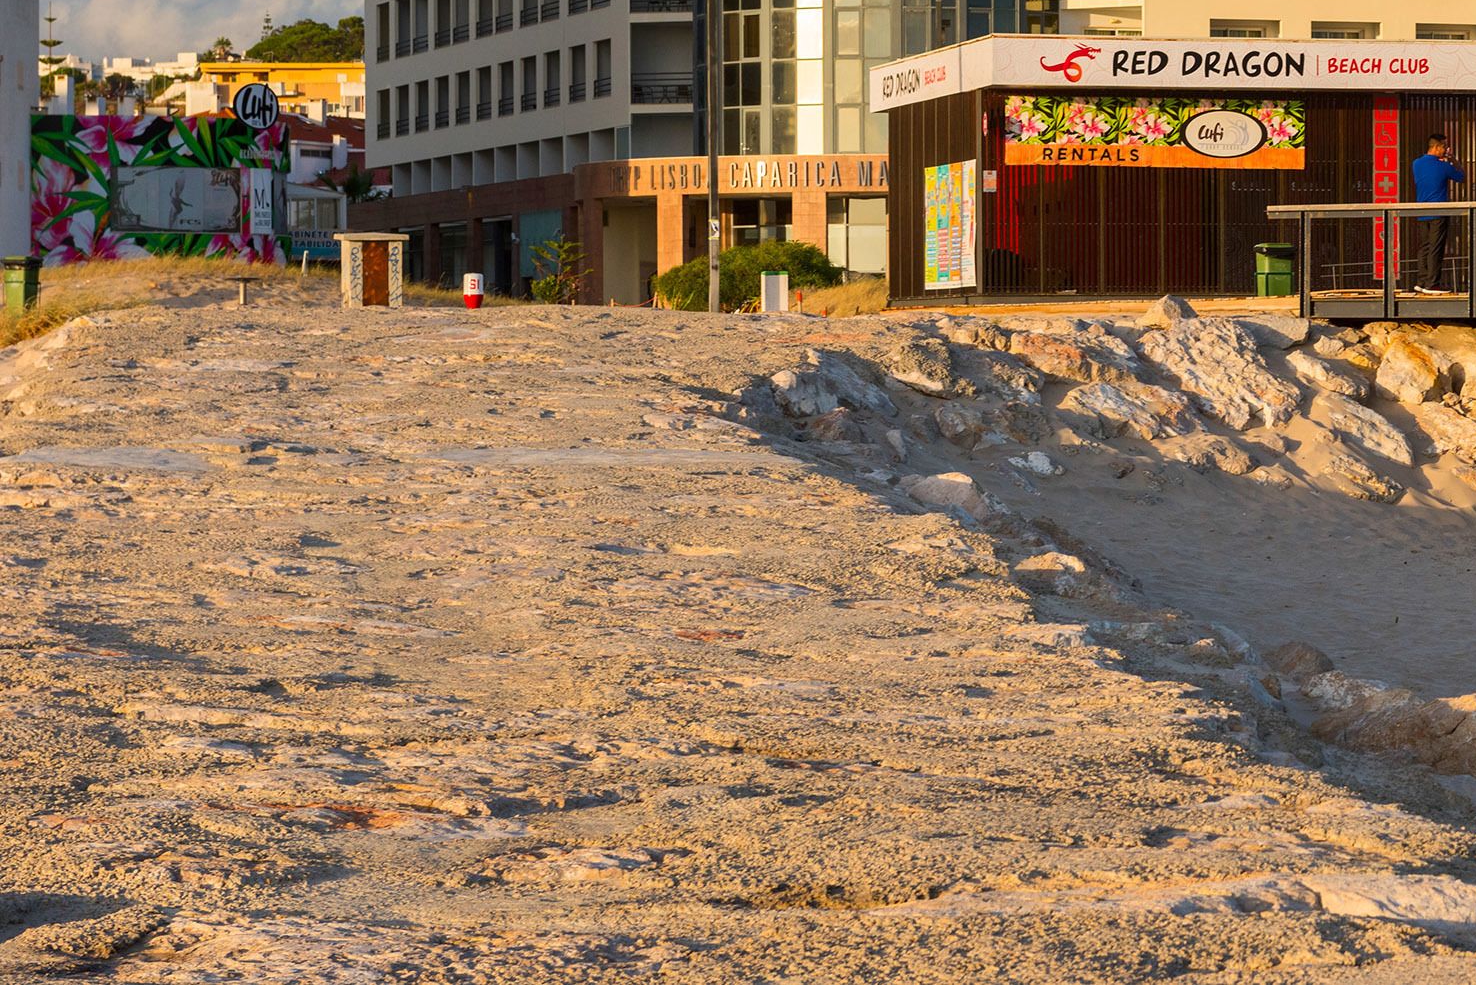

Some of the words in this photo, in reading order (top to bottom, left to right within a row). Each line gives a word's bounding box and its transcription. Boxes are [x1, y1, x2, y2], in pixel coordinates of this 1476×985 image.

[1112, 49, 1169, 77] RED
[1182, 50, 1305, 78] DRAGON
[1327, 57, 1382, 74] BEACH
[1389, 57, 1430, 75] CLUB
[882, 74, 894, 101] RED
[895, 68, 920, 97] DRAGON
[1198, 122, 1224, 143] Lufi
[1042, 147, 1140, 162] RENTALS
[651, 163, 710, 190] LISBO
[729, 160, 842, 188] CAPARICA
